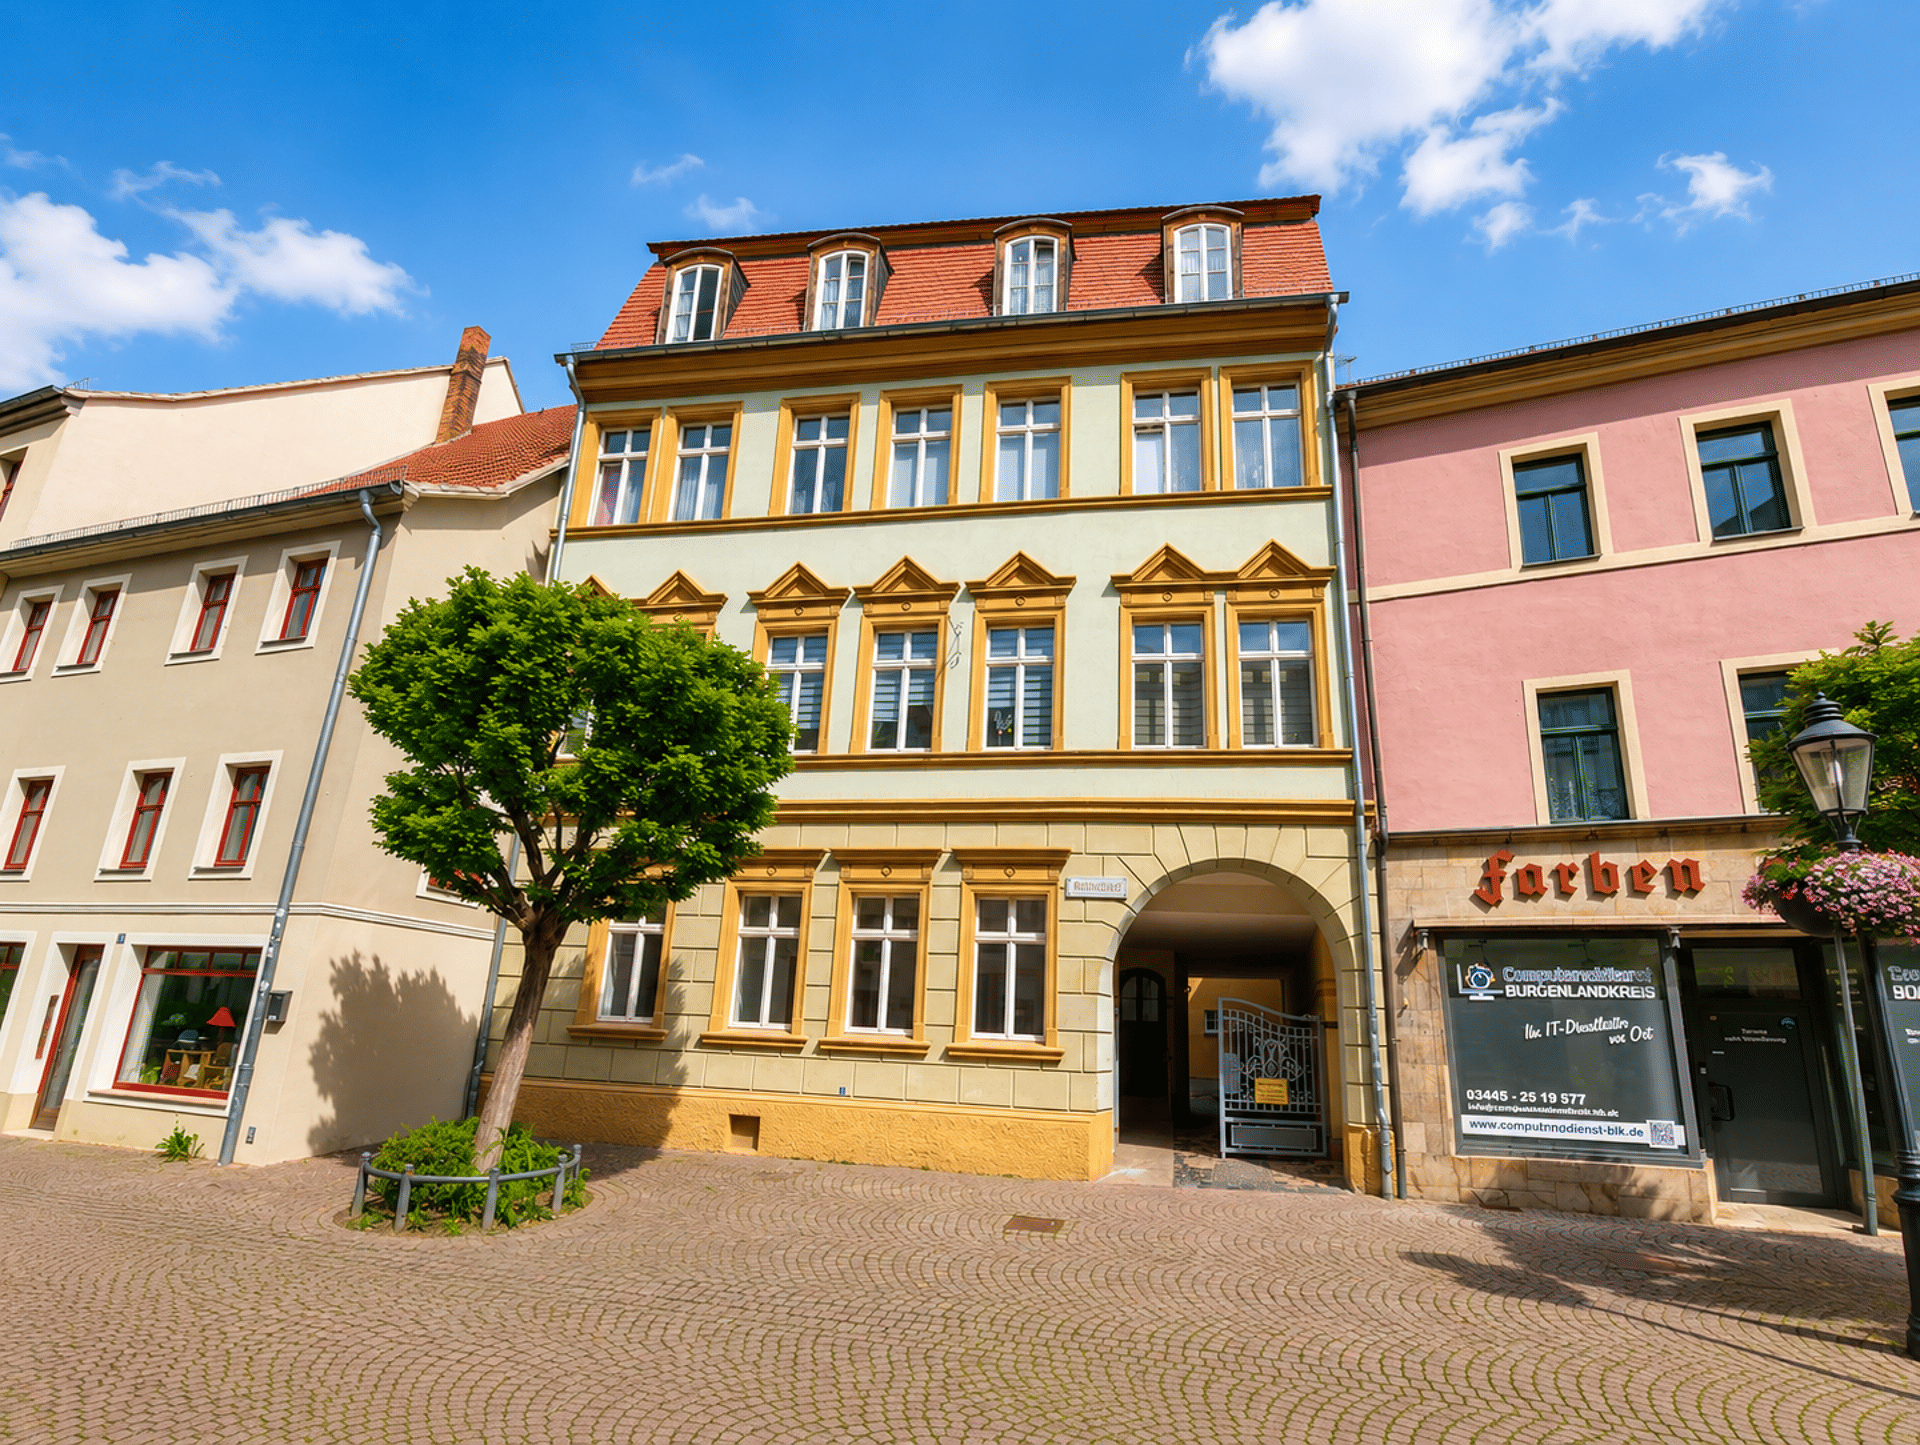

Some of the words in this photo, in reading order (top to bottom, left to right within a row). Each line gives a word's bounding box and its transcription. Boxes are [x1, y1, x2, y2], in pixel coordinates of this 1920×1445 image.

[1505, 984, 1656, 999] BURGENLANDKREIS
[1466, 1089, 1508, 1102] 03445
[1520, 1091, 1536, 1102] 25
[1540, 1092, 1557, 1104] 19
[1560, 1092, 1586, 1105] 577
